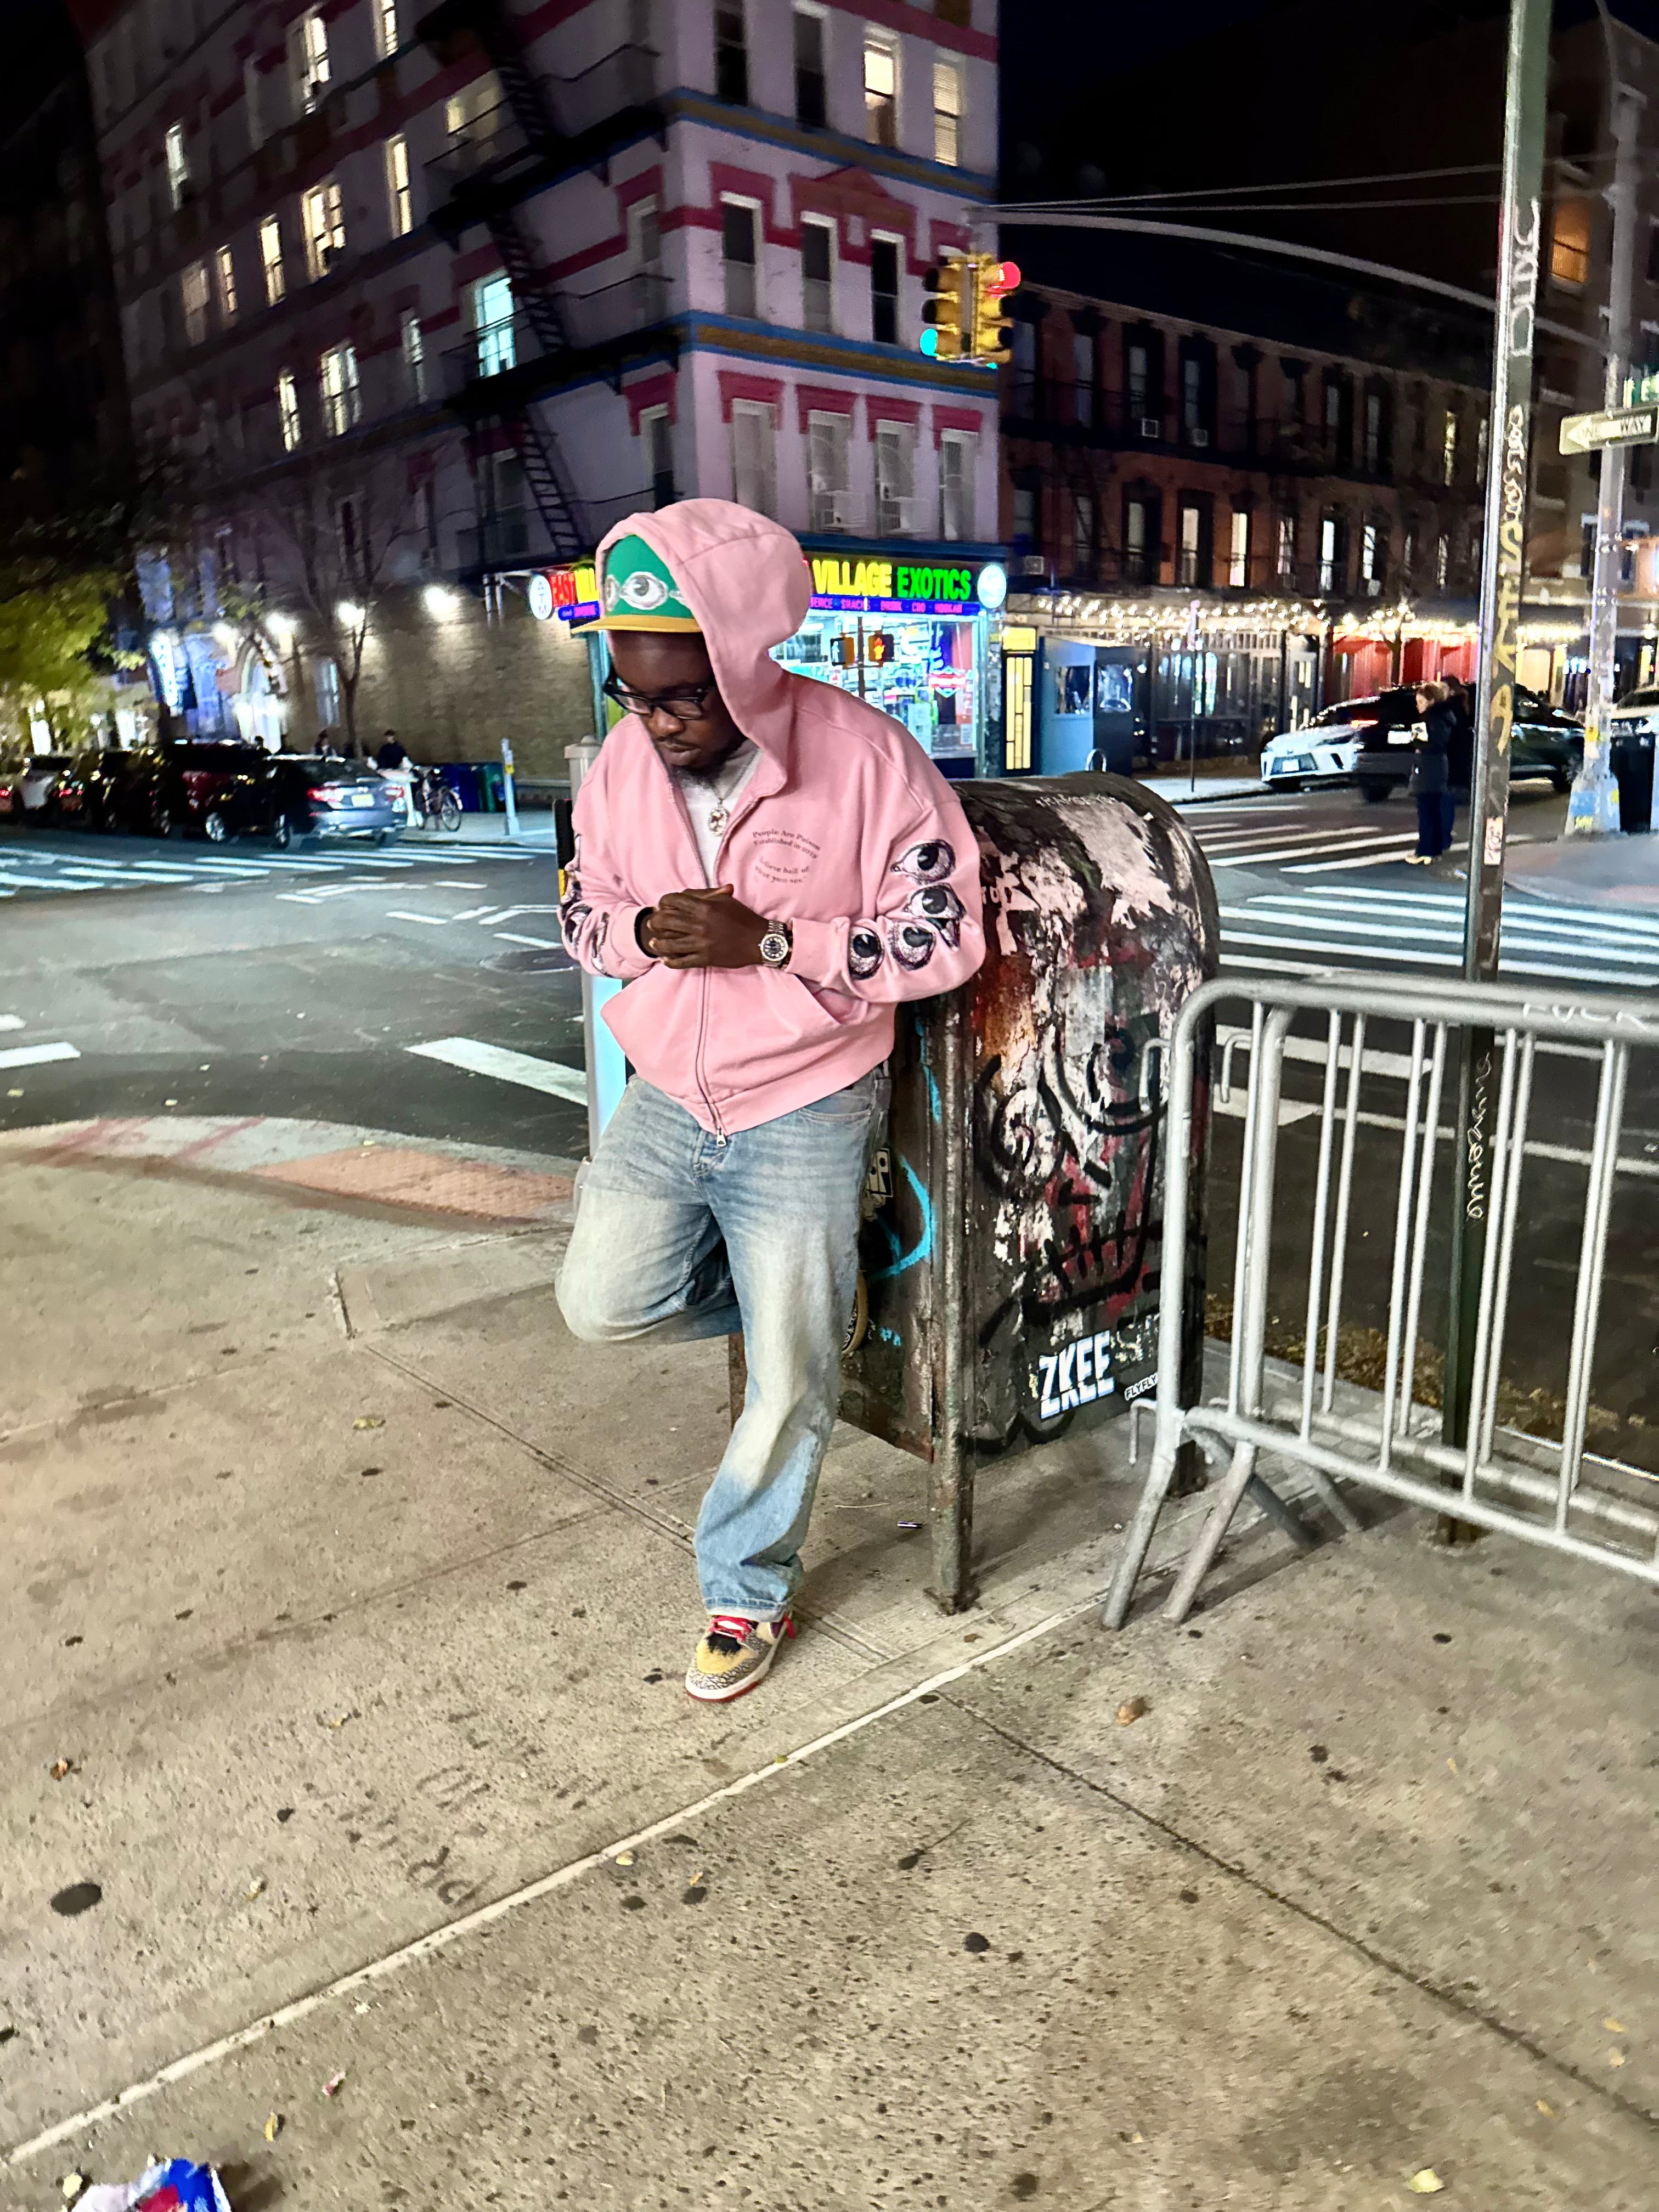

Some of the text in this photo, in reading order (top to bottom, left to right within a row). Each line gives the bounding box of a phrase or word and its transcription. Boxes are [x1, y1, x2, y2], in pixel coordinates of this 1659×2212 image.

[1620, 415, 1646, 437] WAY
[549, 571, 575, 607] EAST
[812, 560, 971, 601] VILLAGE EXOTICS
[538, 582, 547, 615] ATM
[840, 598, 870, 610] SNACS
[753, 830, 779, 838] People
[796, 834, 821, 851] Poison
